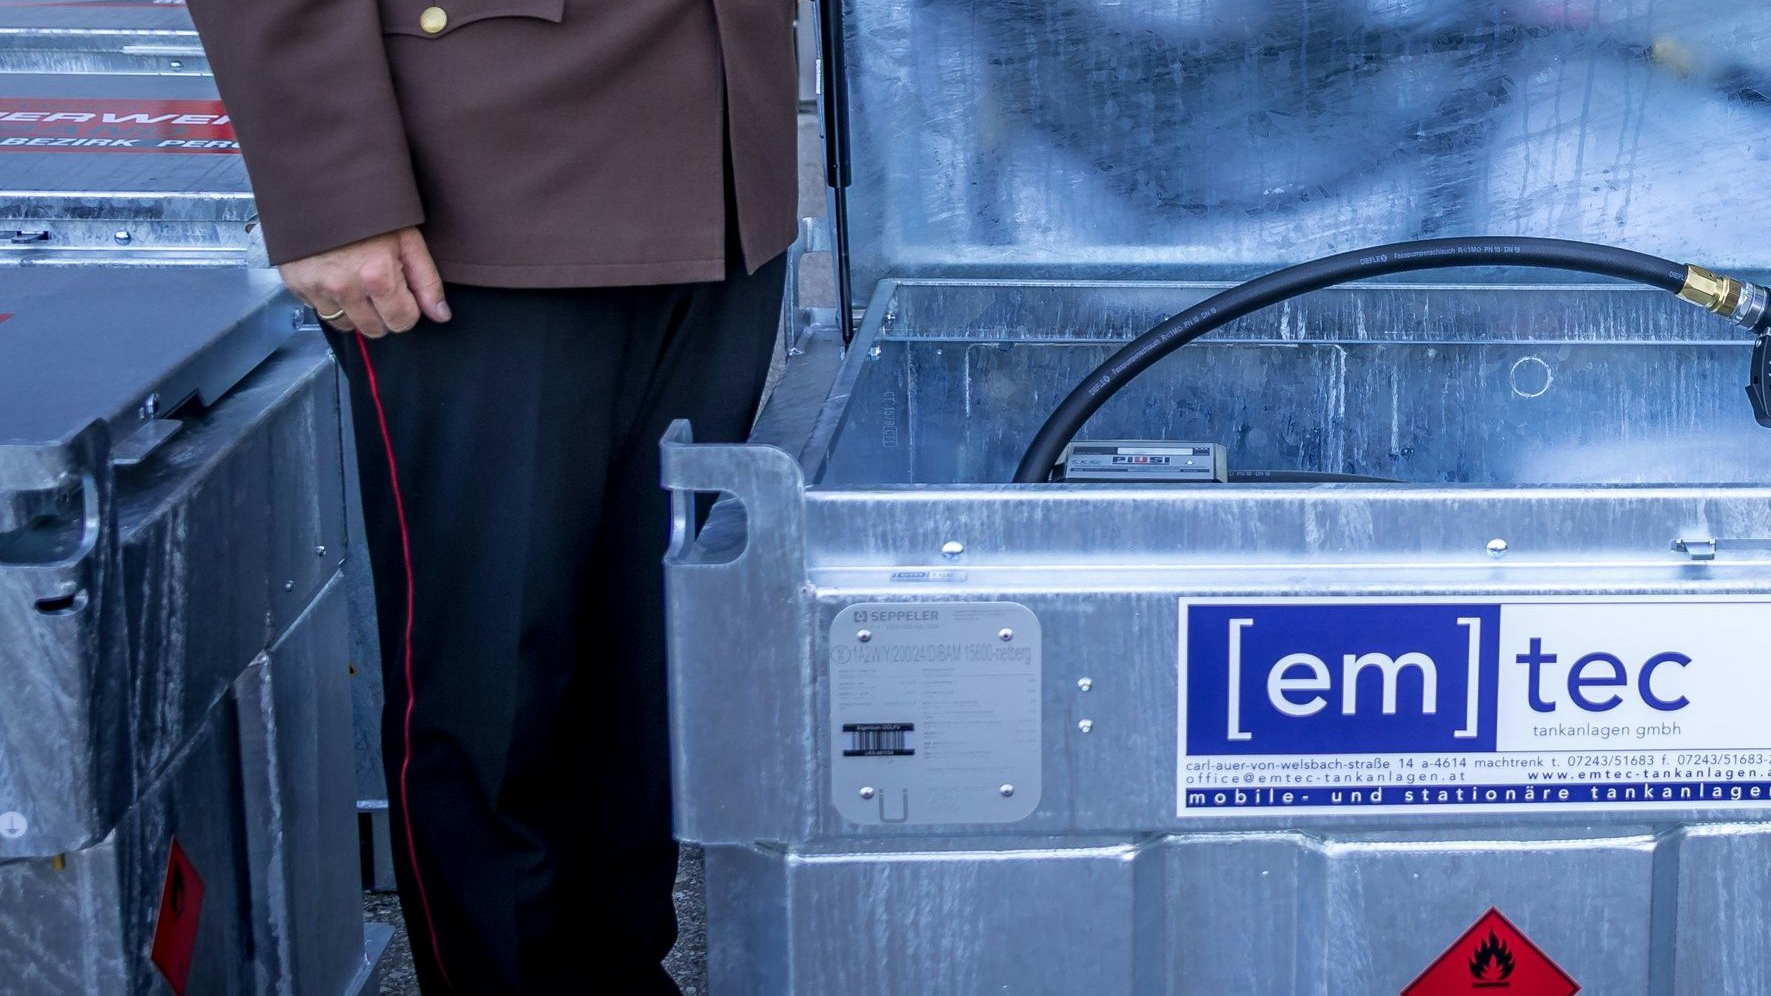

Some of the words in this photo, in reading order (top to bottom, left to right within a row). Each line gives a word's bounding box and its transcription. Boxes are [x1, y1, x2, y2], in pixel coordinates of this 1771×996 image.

[0, 136, 140, 147] BEZIRK
[1112, 456, 1170, 464] PIUSI
[871, 610, 939, 622] SEPPELER
[1533, 722, 1630, 739] tankanlagen
[1636, 721, 1682, 739] gmbh
[1186, 757, 1390, 771] carl-auer-von-welsbach-straße
[1399, 758, 1414, 769] 14
[1422, 757, 1467, 769] a-4614
[1475, 755, 1544, 769] machtrenk
[1552, 757, 1560, 767] t.
[1567, 755, 1655, 767] 07243/51683
[1661, 754, 1671, 766] f.
[1186, 770, 1466, 785] office@emtec-tankanlagen.at
[1188, 787, 1310, 804] mobile-
[1332, 786, 1383, 802] und
[1405, 784, 1570, 803] stationäre
